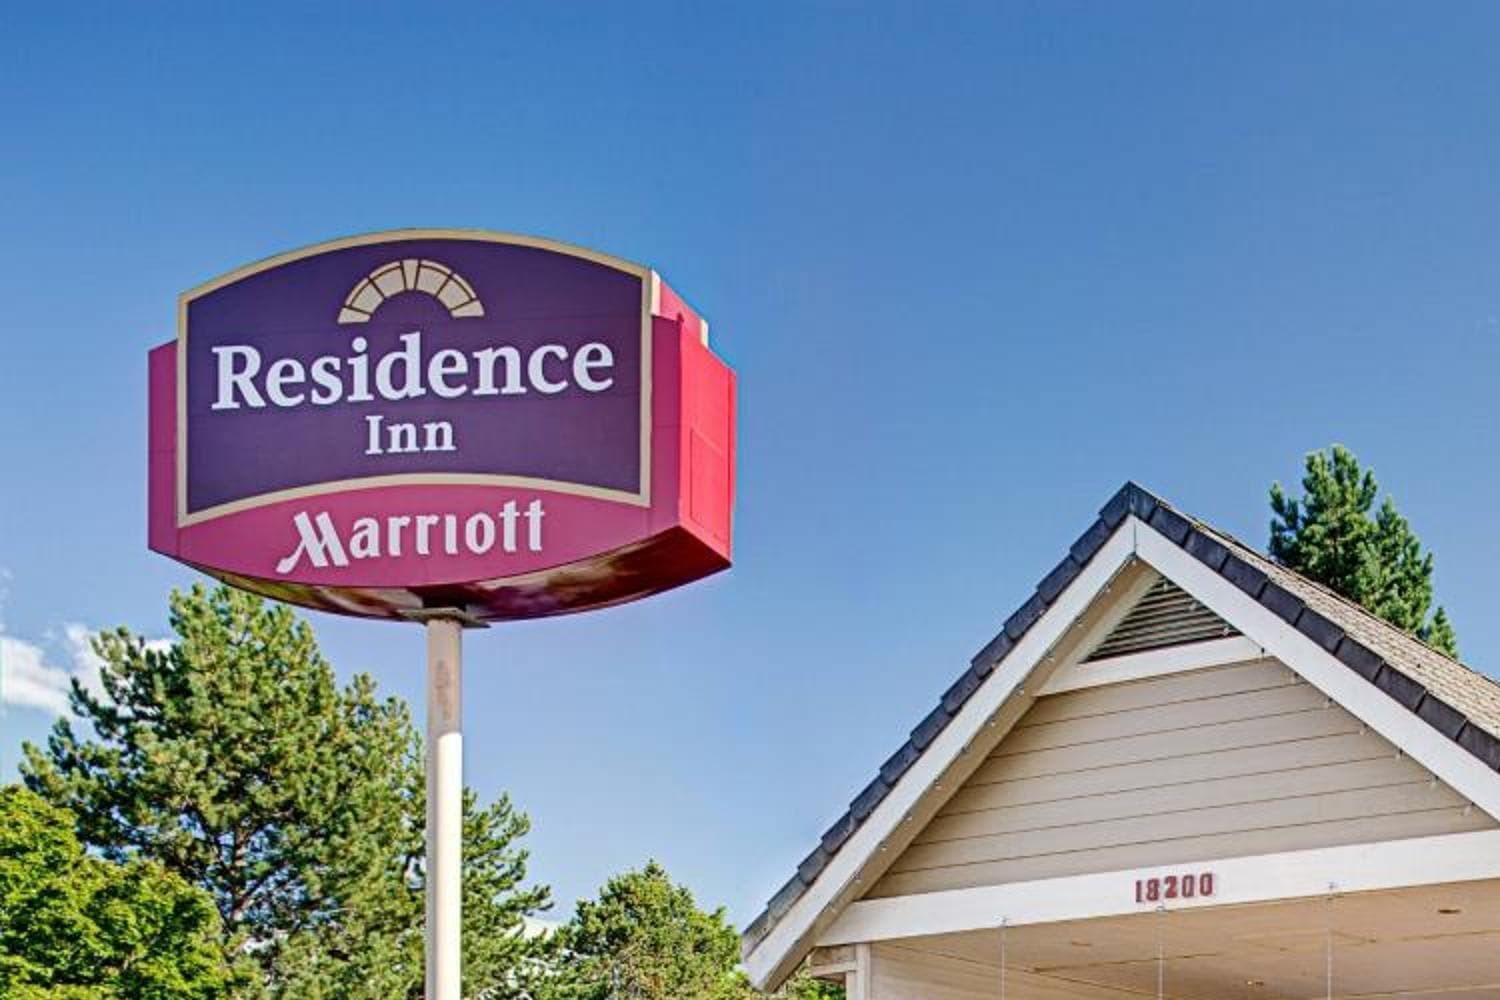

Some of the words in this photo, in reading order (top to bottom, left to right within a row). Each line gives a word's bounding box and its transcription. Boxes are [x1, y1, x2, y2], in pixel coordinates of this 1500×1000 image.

[211, 331, 615, 411] Residence
[365, 415, 456, 455] Inn
[276, 499, 545, 574] Marriott
[1135, 873, 1213, 903] 18200
